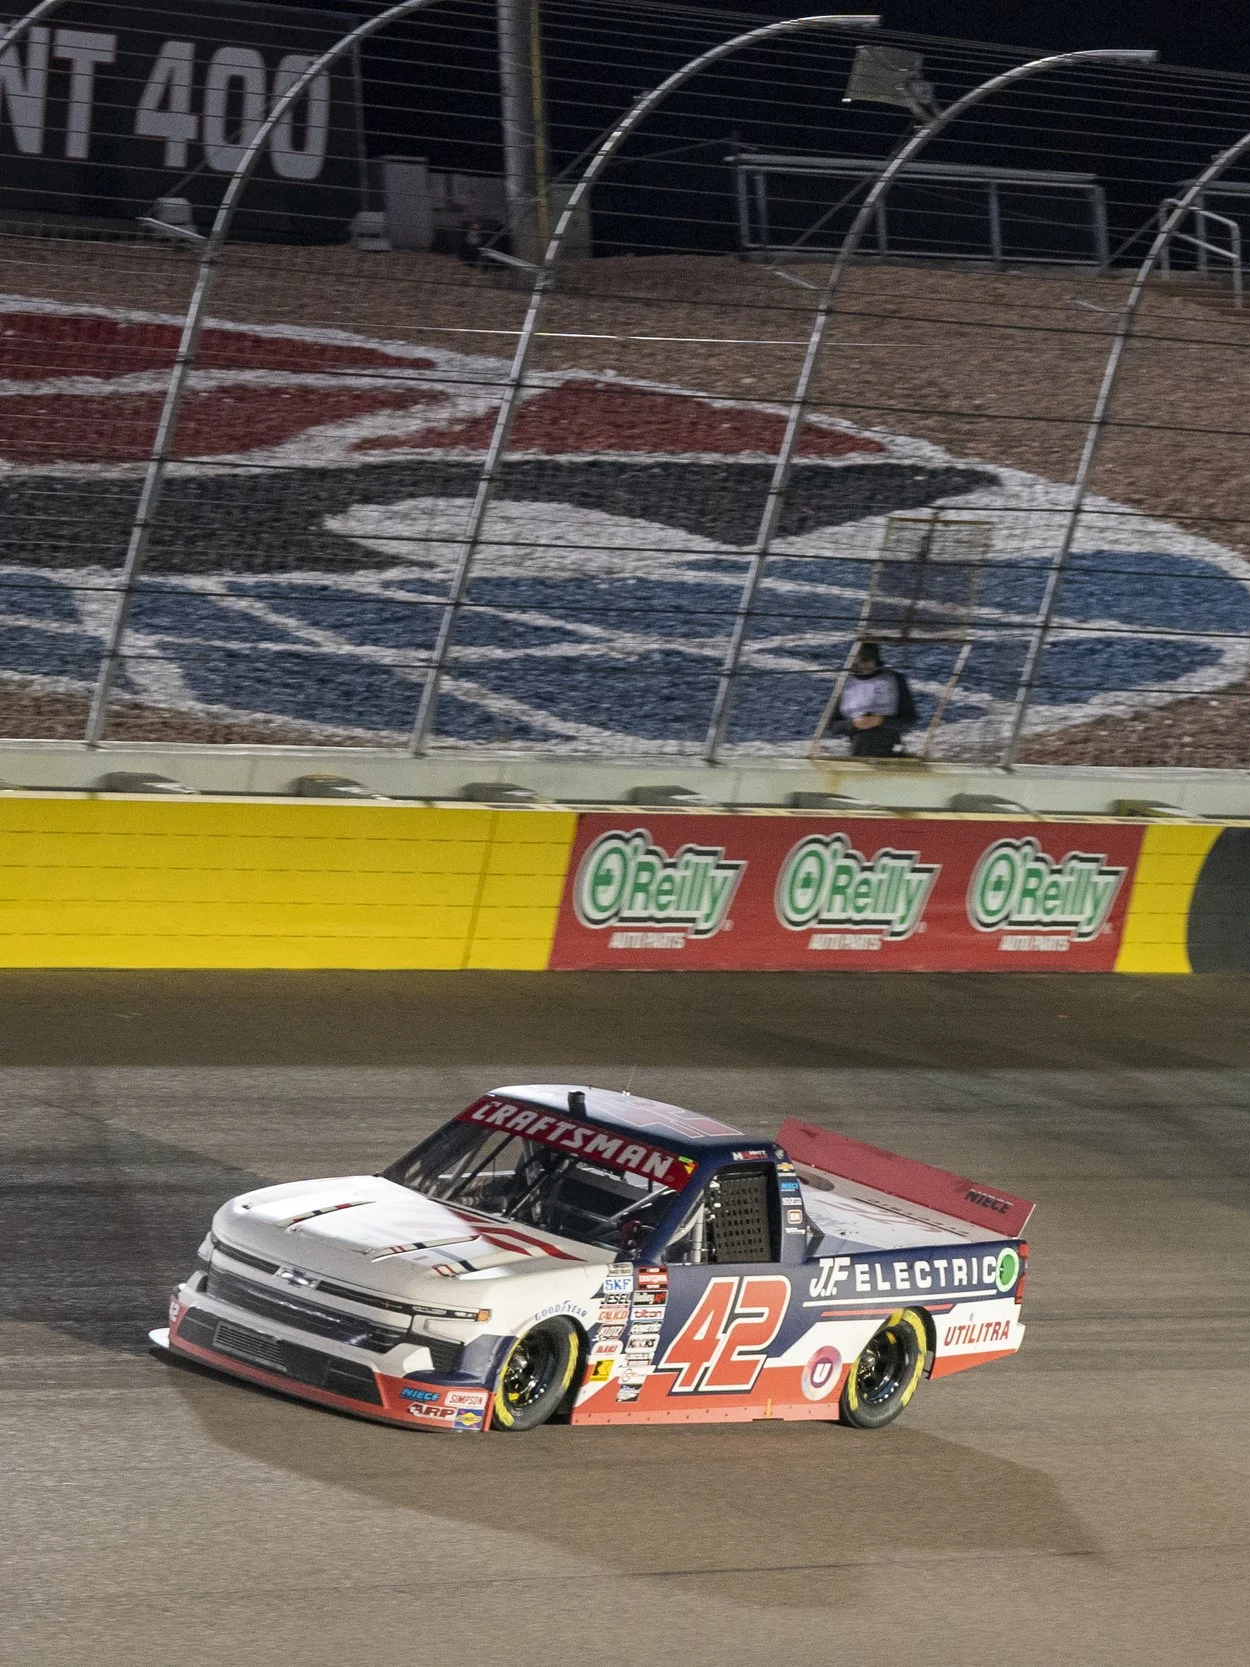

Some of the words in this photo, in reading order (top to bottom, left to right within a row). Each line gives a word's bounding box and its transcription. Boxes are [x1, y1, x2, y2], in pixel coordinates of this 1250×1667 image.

[133, 40, 331, 180] 400
[579, 834, 736, 931] O'Reilly
[784, 838, 933, 933] O'Reilly
[974, 843, 1120, 936] O'Reilly
[470, 1102, 675, 1179] CRAFTSMAN
[964, 1189, 1015, 1215] NIECE
[605, 1279, 631, 1291] SKF
[854, 1255, 998, 1292] ELECTRIC
[534, 1300, 588, 1321] GOODYEAR
[601, 1293, 629, 1305] JESEL
[657, 1275, 791, 1396] 42
[944, 1320, 1011, 1347] UTILITRA
[401, 1387, 440, 1401] NIECE
[408, 1403, 456, 1418] ARP
